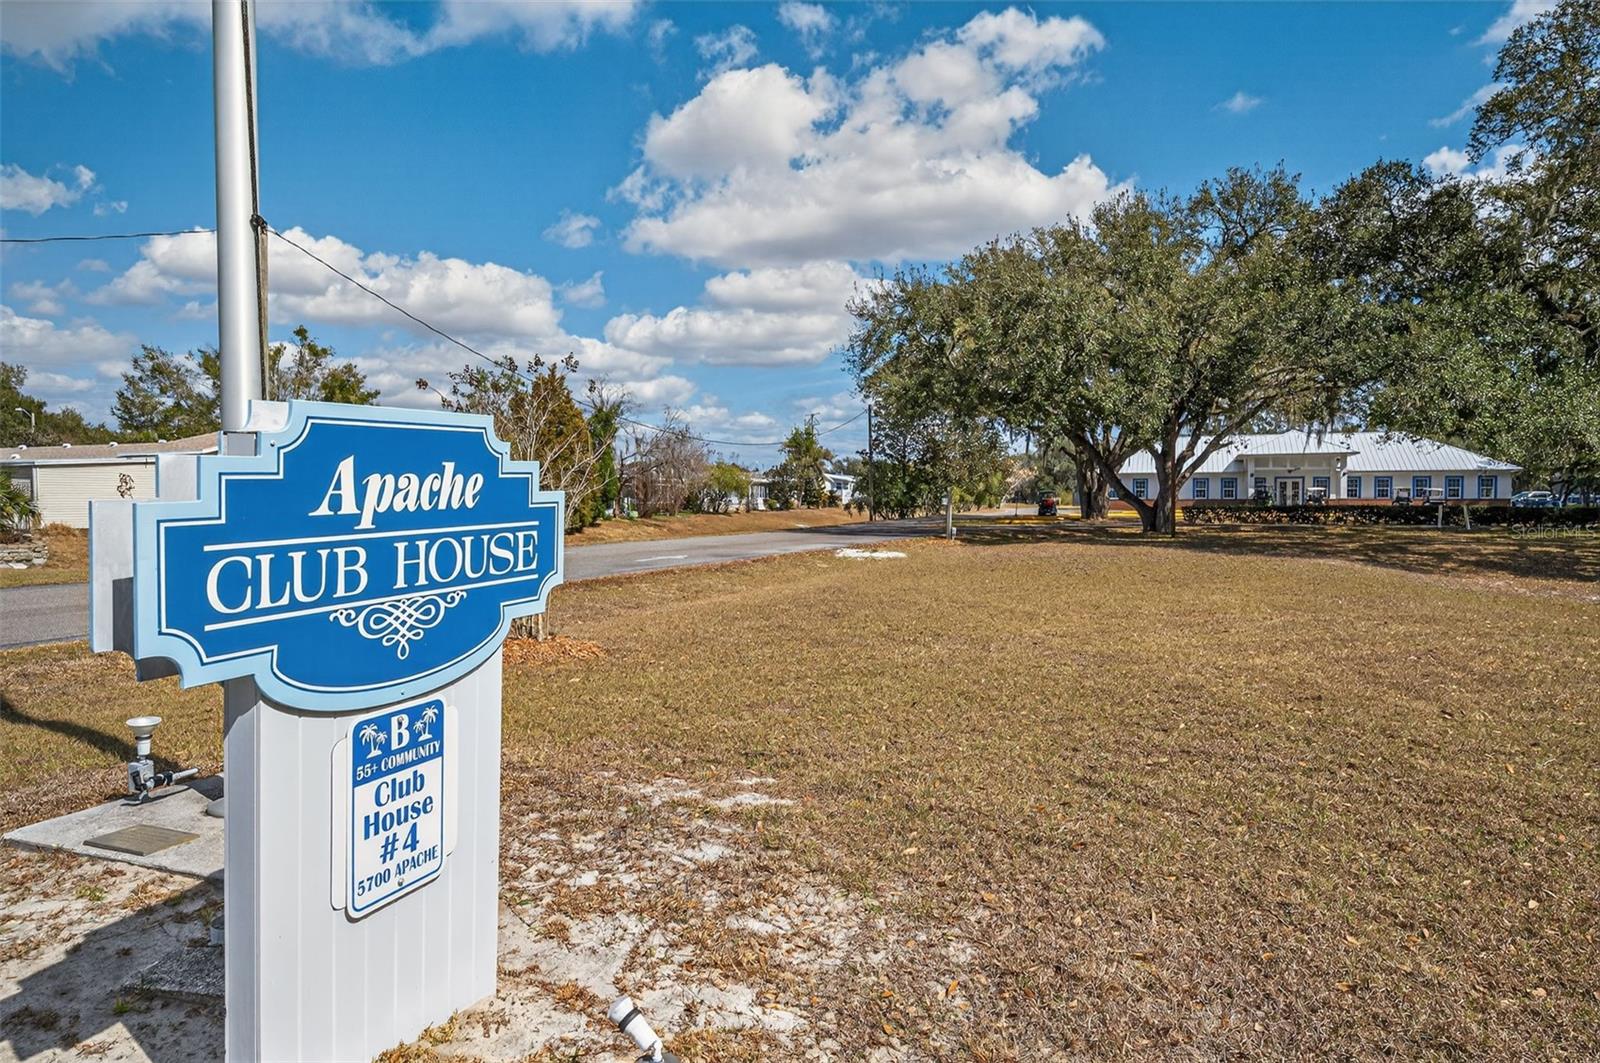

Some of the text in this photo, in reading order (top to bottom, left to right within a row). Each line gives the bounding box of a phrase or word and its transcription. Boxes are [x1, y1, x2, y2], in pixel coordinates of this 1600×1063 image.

[308, 455, 484, 530] Apache
[206, 530, 539, 614] CLUB HOUSE
[391, 713, 410, 751] B
[356, 740, 441, 781] 55+ COMMUNITY
[374, 769, 425, 807] Club
[363, 795, 434, 840] House
[357, 844, 439, 897] 5700 APACHE
